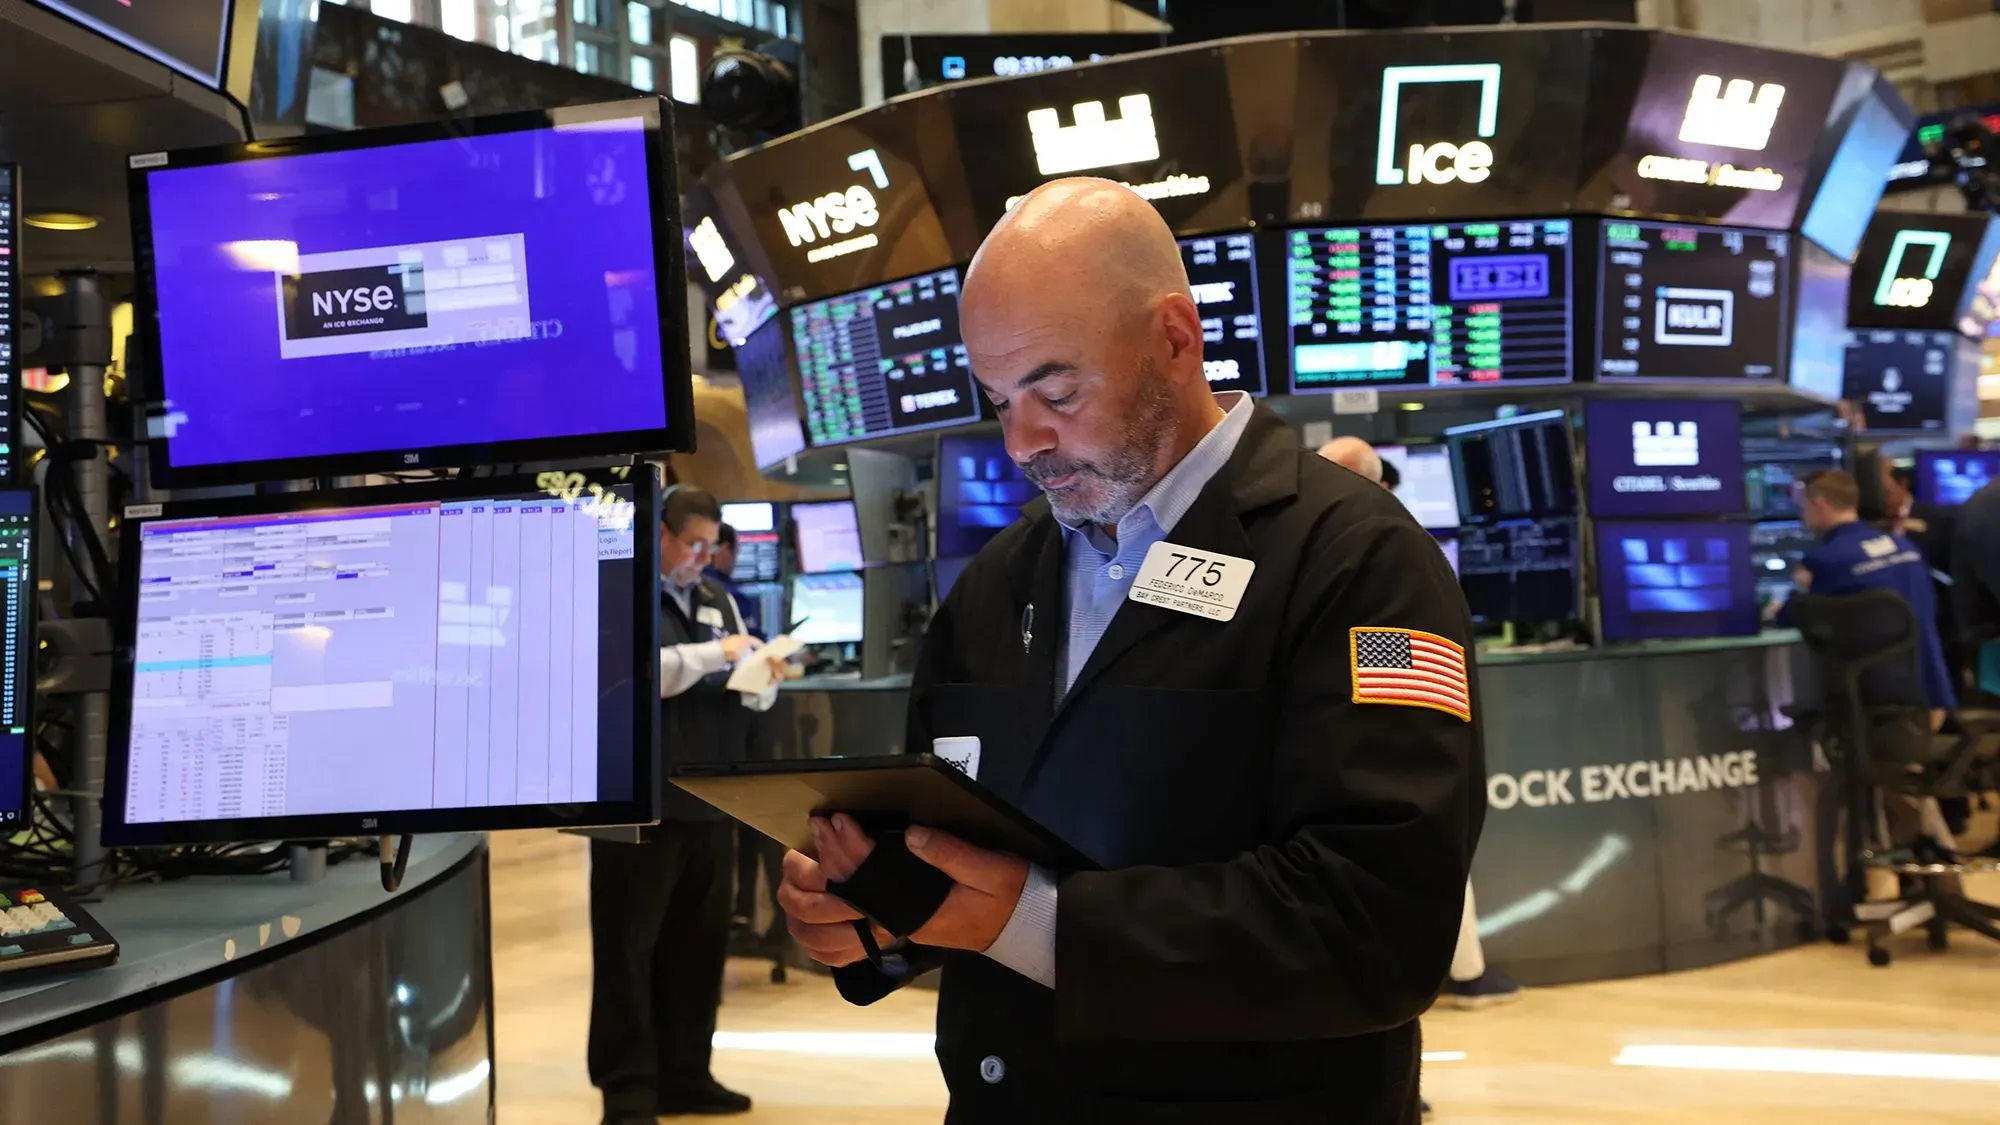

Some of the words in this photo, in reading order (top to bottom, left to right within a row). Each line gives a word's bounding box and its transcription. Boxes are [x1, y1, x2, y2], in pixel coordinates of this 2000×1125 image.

[404, 453, 419, 464] 3M
[600, 536, 617, 544] Login
[610, 547, 632, 555] Report
[1165, 553, 1226, 586] 775
[1149, 578, 1185, 593] FEDERICO
[1187, 586, 1225, 602] DeMARCO
[1136, 591, 1149, 599] BAY
[1151, 594, 1171, 604] CREST
[1208, 607, 1222, 616] LLC
[1487, 768, 1575, 810] OCK
[1580, 750, 1758, 802] EXCHANGE
